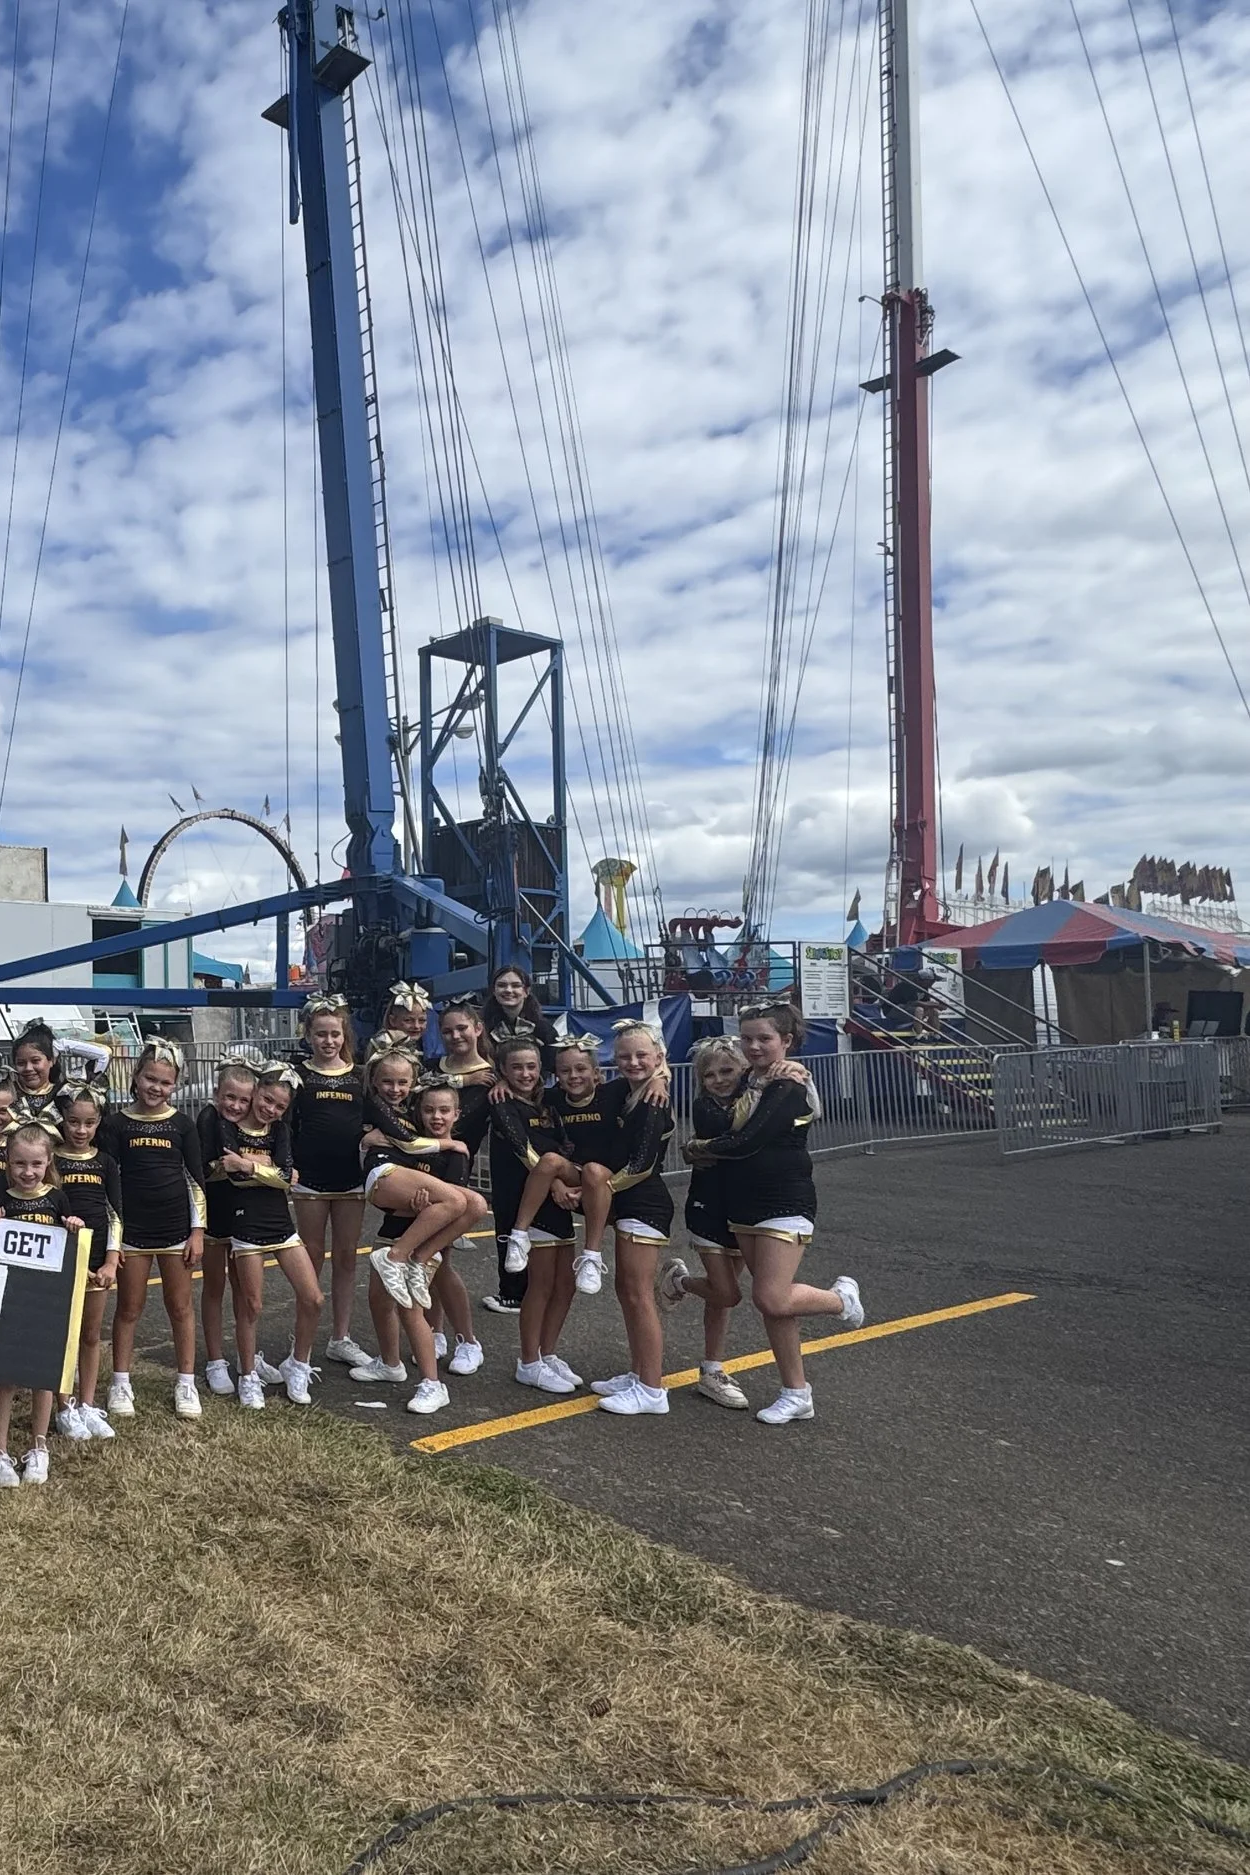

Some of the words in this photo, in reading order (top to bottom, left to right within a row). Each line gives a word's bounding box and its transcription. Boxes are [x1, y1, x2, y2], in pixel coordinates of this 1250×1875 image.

[315, 1091, 353, 1102] INFERNO
[129, 1137, 172, 1149] INFERNO
[3, 1229, 51, 1259] GET
